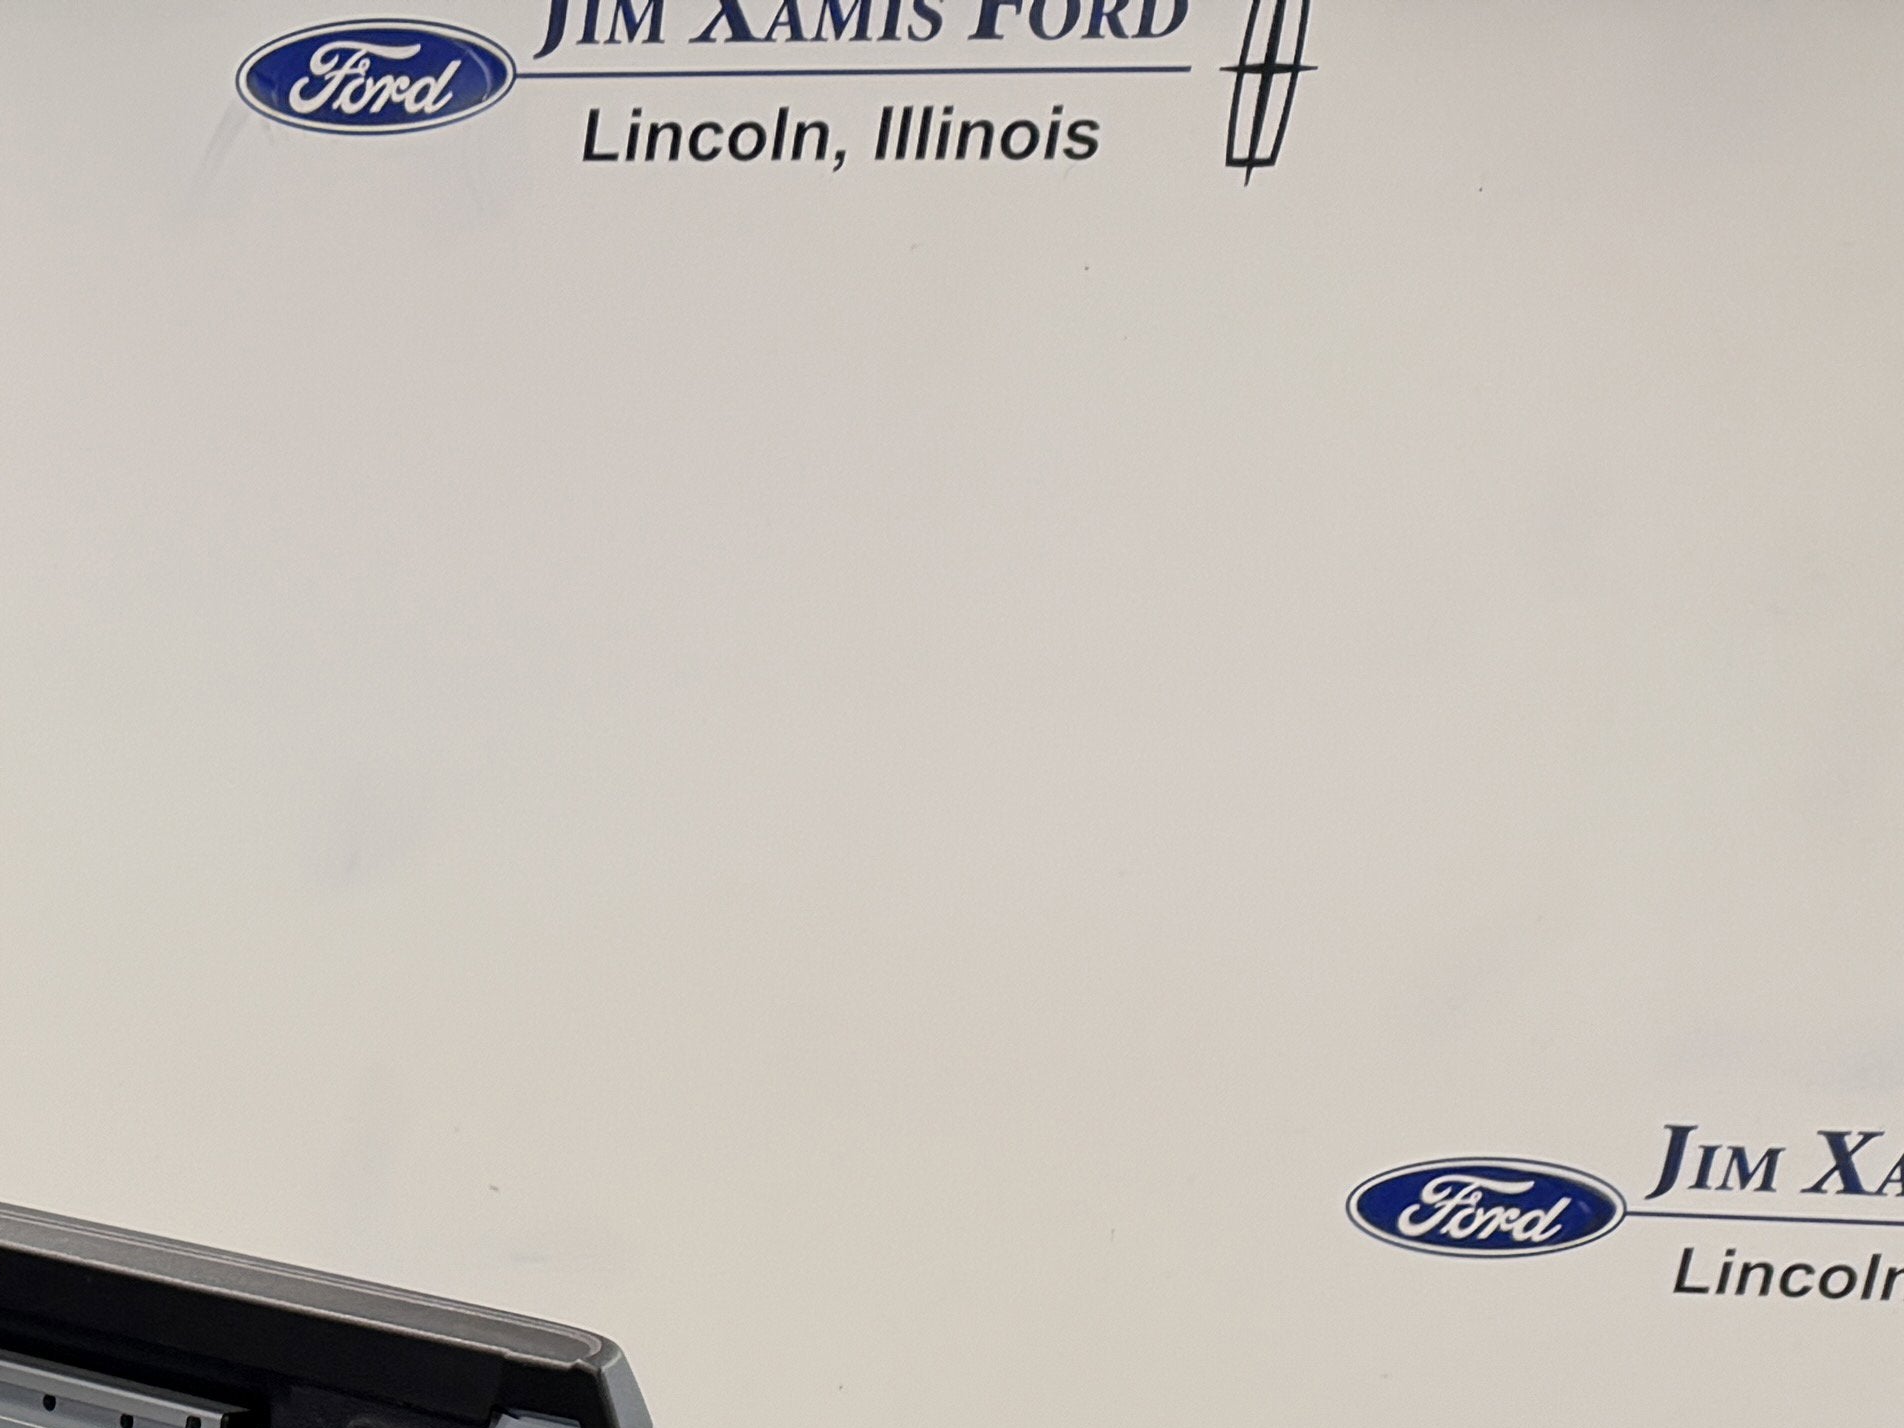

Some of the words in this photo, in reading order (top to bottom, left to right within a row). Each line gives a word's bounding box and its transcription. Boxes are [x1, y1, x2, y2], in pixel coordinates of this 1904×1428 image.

[288, 40, 457, 118] Ford
[582, 106, 846, 173] Lincoln,
[874, 105, 1100, 161] Illinois
[1644, 1124, 1786, 1201] JIM
[1397, 1174, 1571, 1243] Ford
